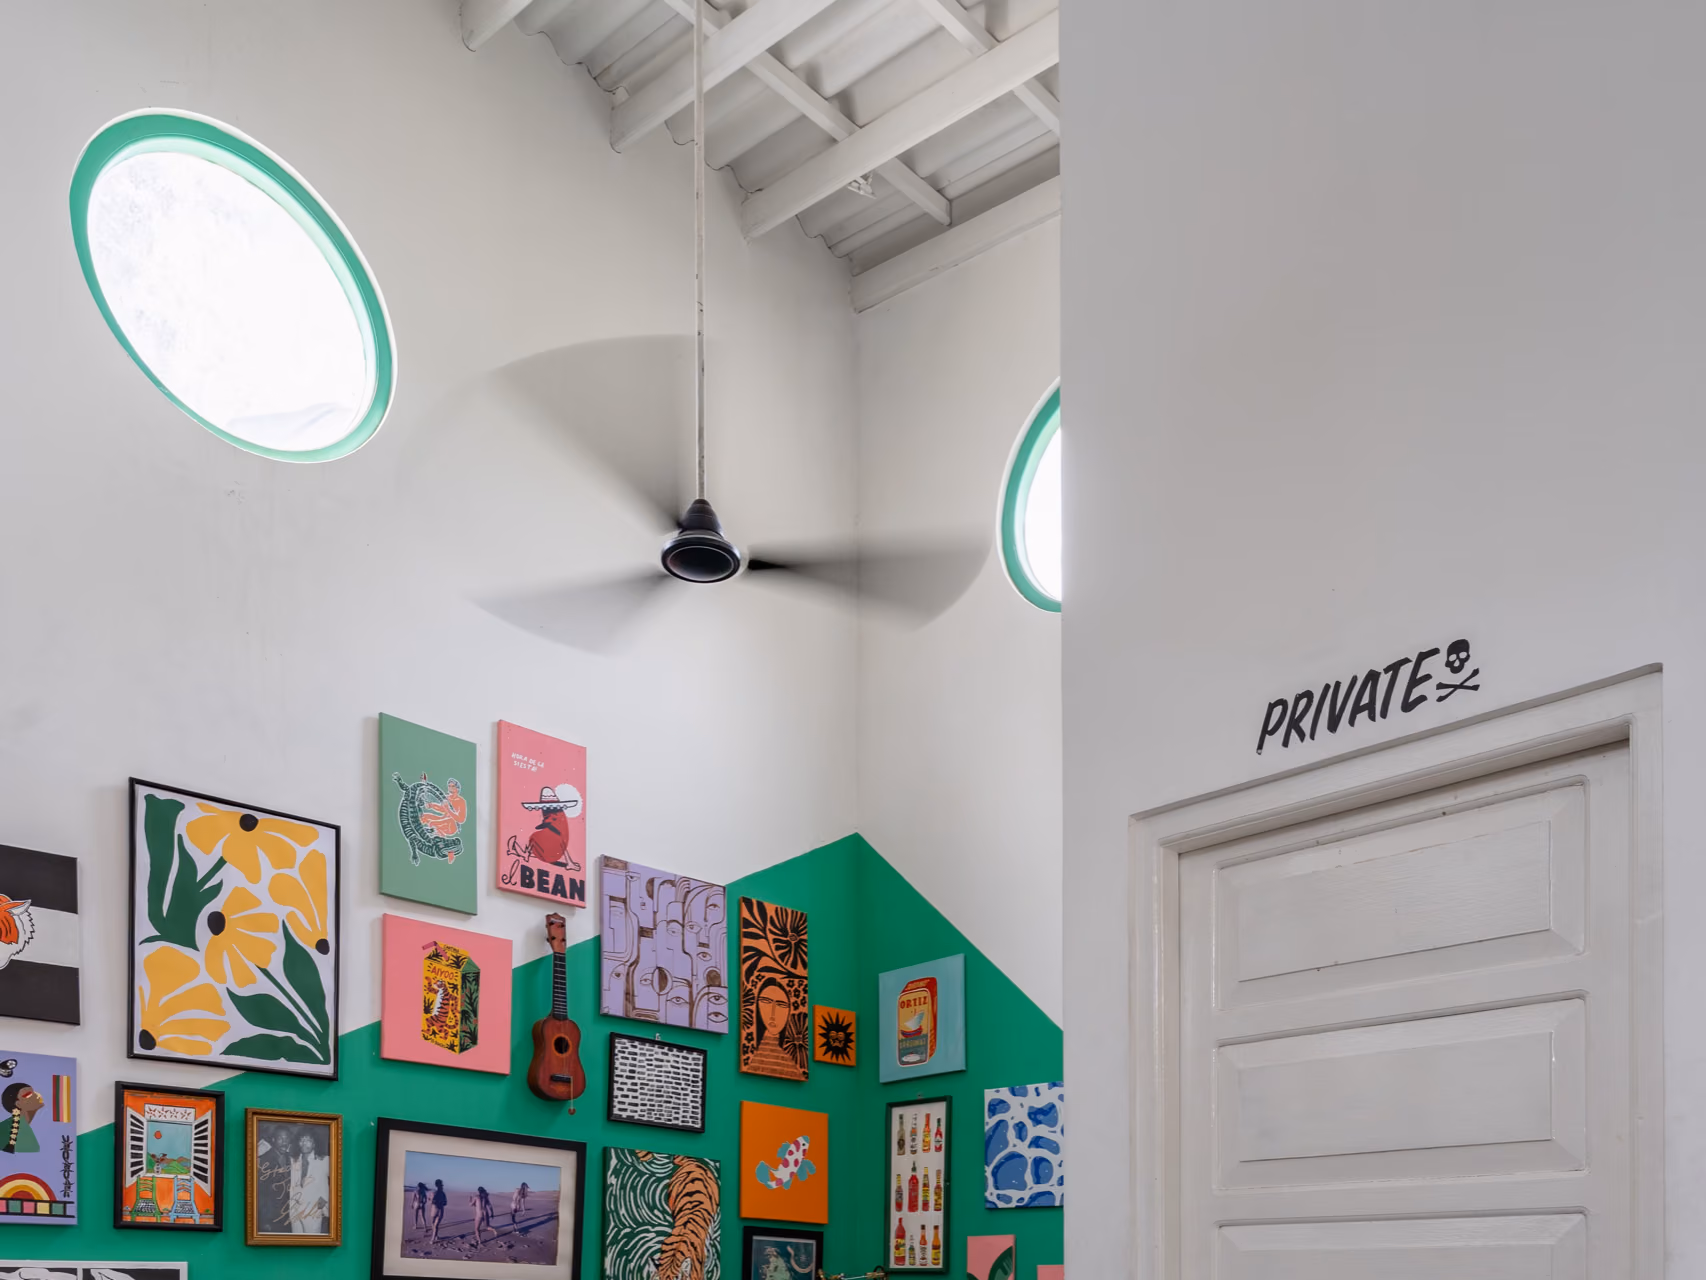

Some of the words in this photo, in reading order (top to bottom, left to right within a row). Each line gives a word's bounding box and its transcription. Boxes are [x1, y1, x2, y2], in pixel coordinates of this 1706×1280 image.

[1256, 647, 1441, 755] PRIVATE
[501, 859, 520, 886] el
[520, 864, 586, 902] BEAN
[431, 965, 455, 980] AIYOO
[900, 996, 928, 1009] ORTIZ
